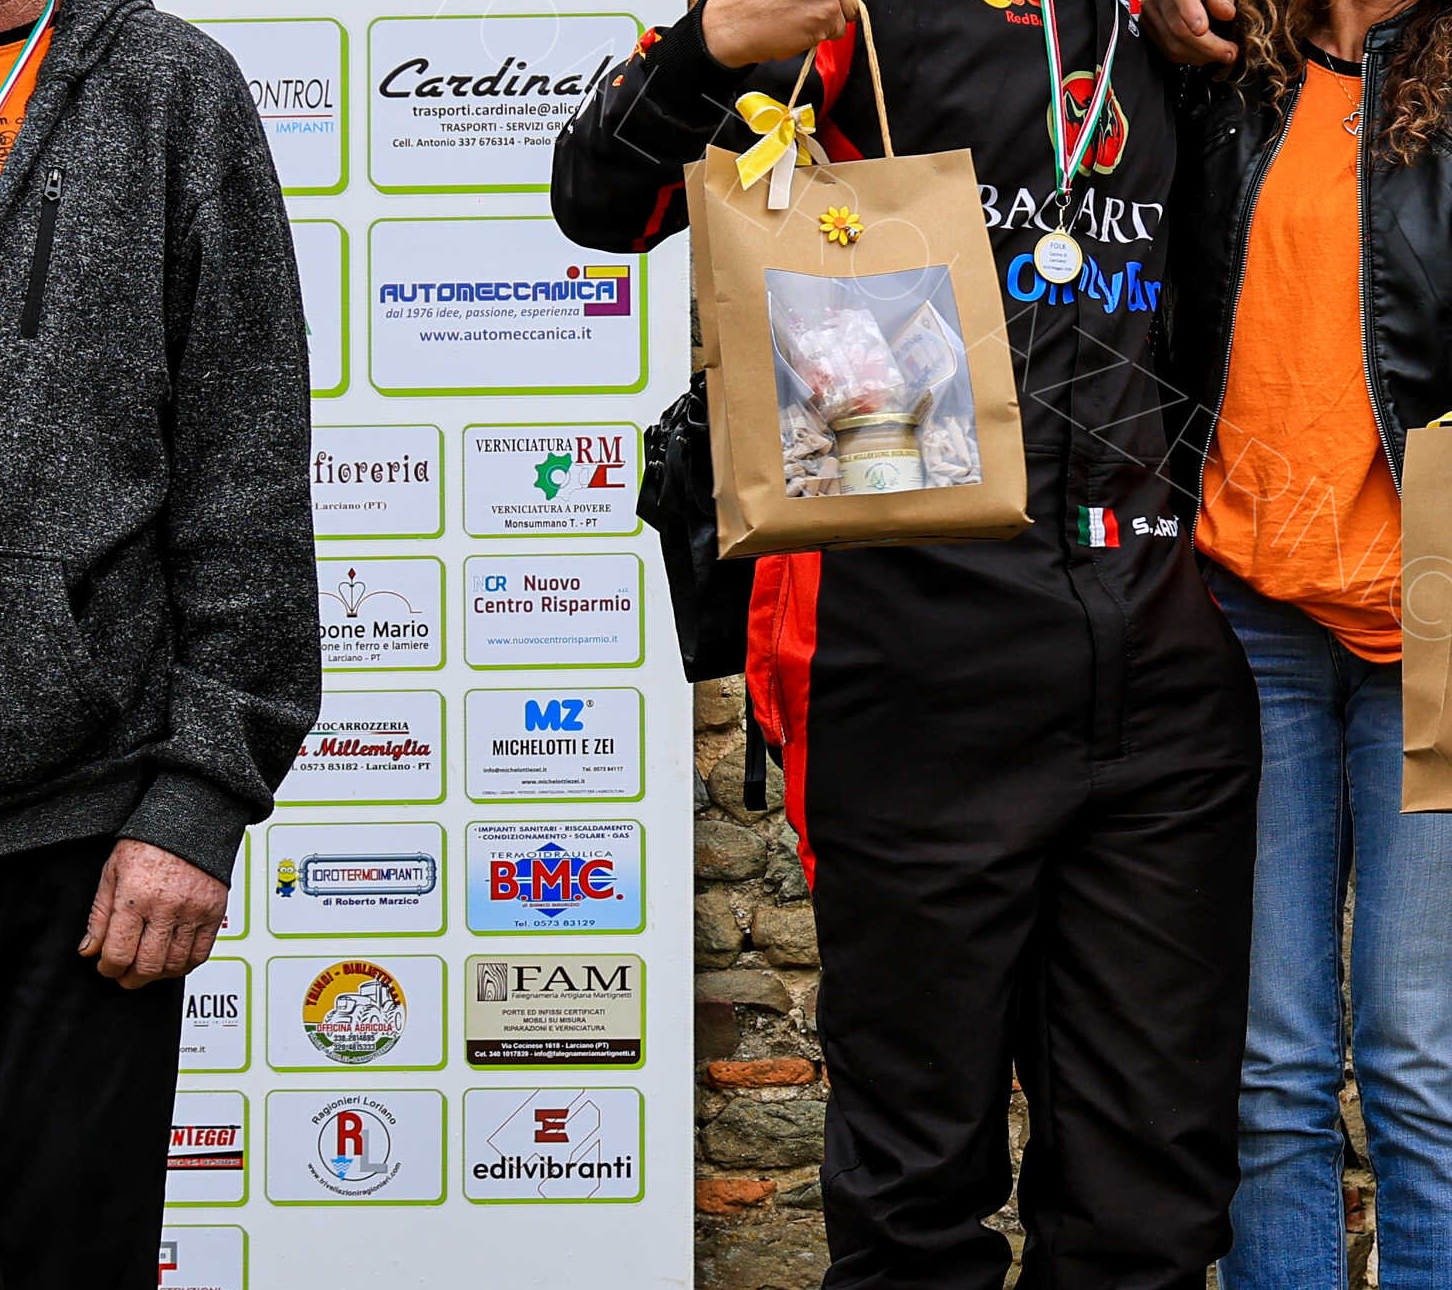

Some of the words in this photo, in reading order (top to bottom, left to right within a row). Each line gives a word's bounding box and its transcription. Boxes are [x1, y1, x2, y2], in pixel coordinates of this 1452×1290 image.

[378, 55, 614, 99] Cardinal
[250, 78, 333, 109] ONTROL
[275, 122, 334, 134] IMPIANTI
[440, 122, 497, 132] TRASPORTI
[506, 122, 544, 132] SERVIZI
[393, 139, 413, 148] Cell.
[416, 138, 456, 148] Antonio
[458, 138, 476, 147] 337
[479, 137, 515, 147] 676314
[524, 137, 551, 146] Paolo
[380, 274, 615, 303] AUTOMECCANICA
[386, 307, 403, 319] dal
[407, 308, 432, 318] 1976
[466, 308, 516, 320] passione,
[521, 307, 579, 320] esperienza
[420, 326, 592, 342] www.automeccanica.it
[476, 439, 572, 453] VERNICIATURA
[315, 501, 361, 510] Larciano
[363, 500, 387, 511] (PT)
[491, 505, 563, 515] VERNICIATURA
[573, 504, 611, 513] POVERE
[504, 519, 568, 529] Monsummano
[586, 518, 598, 528] PT
[523, 575, 580, 591] Nuovo
[474, 596, 533, 614] Centro
[541, 595, 631, 615] Risparmio
[373, 620, 429, 639] Mario
[354, 640, 380, 651] ferro
[392, 640, 429, 650] lamiere
[487, 635, 618, 646] www.nuovocentrorisparmio.it
[328, 653, 363, 662] Larciano
[370, 653, 381, 662] PT
[525, 699, 584, 732] MZ
[313, 737, 431, 760] Millemiglia
[492, 738, 576, 756] MICHELOTTI
[583, 739, 589, 755] E
[594, 738, 614, 755] ZEI
[300, 763, 325, 771] 0573
[328, 762, 358, 771] 83182
[366, 762, 410, 771] Larciano
[418, 762, 430, 771] PT
[313, 868, 423, 881] IDROTERMOIMPIANTI
[490, 859, 624, 901] B.M.C.
[323, 898, 332, 906] di
[336, 898, 376, 906] Roberto
[380, 897, 419, 905] Marzico
[512, 966, 632, 991] FAM
[186, 995, 238, 1018] ACUS
[317, 1024, 352, 1032] OFFICINA
[355, 1023, 392, 1031] AGRICOLA
[311, 1096, 360, 1125] Ragionieri
[363, 1097, 396, 1125] Loriano
[172, 1126, 236, 1146] NTEGGI
[472, 1155, 632, 1180] edilvibranti
